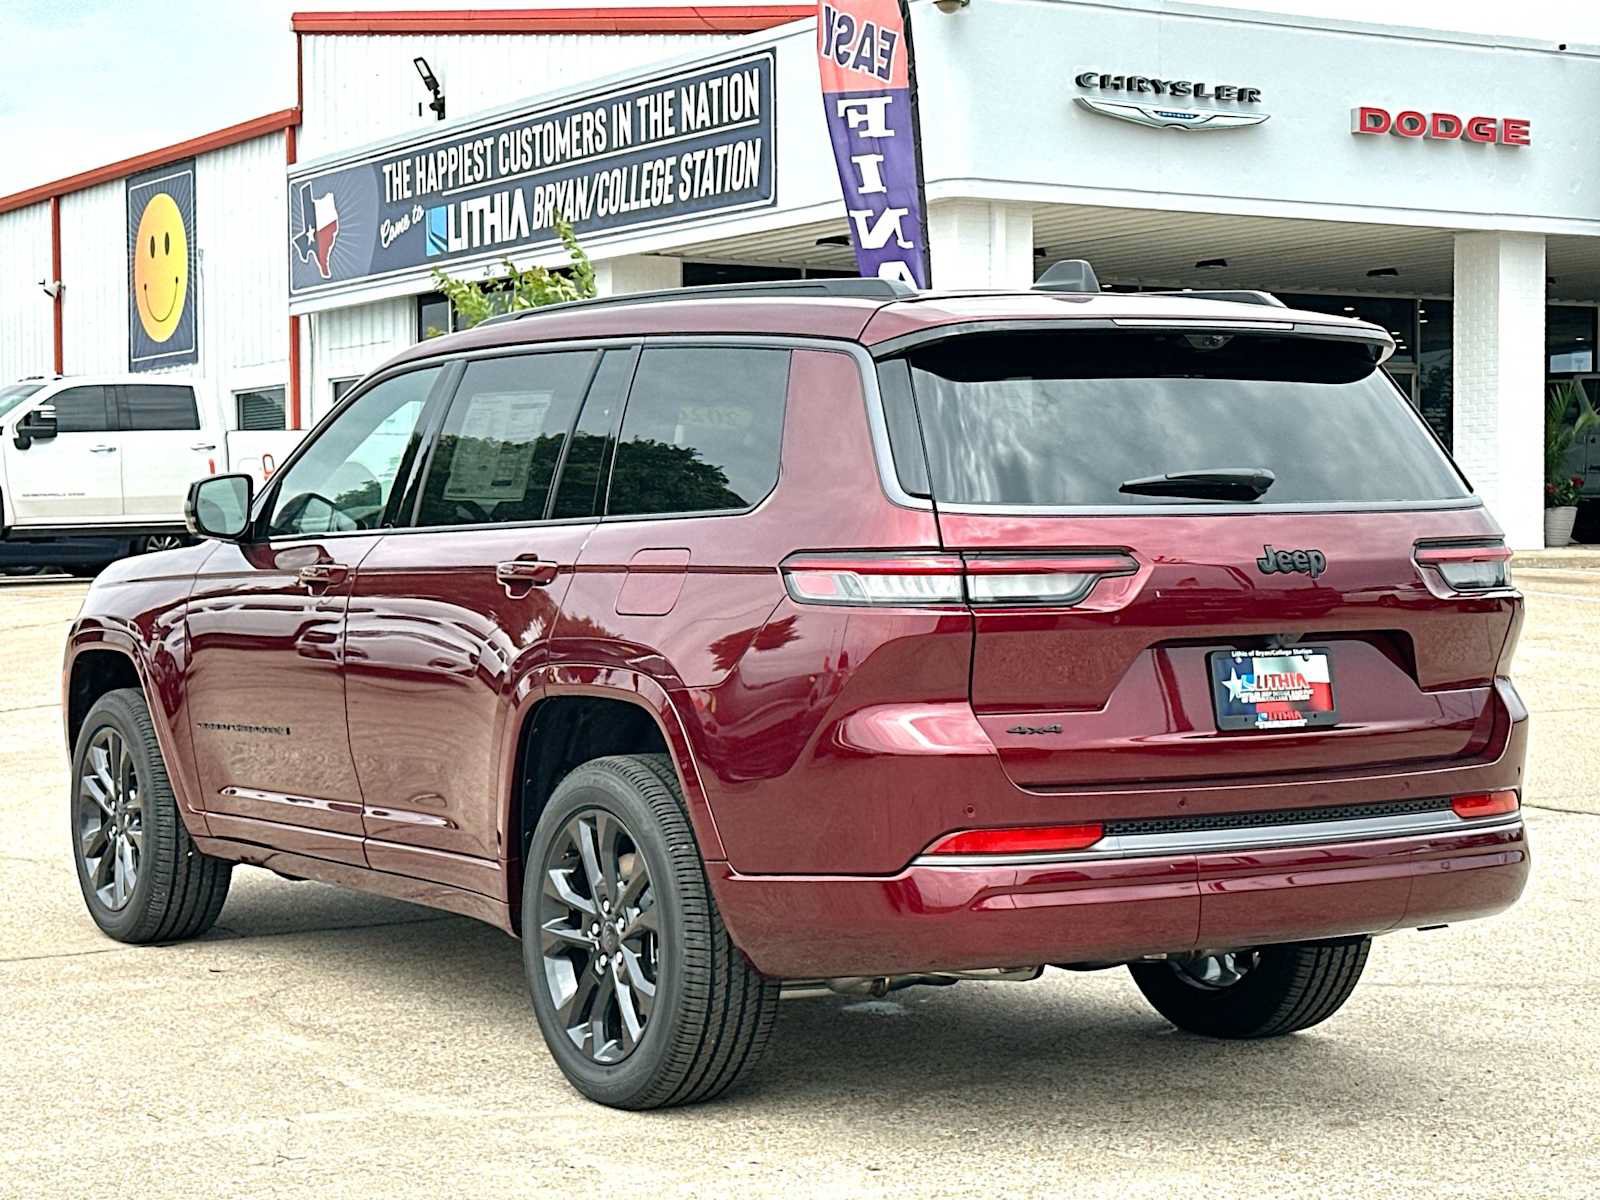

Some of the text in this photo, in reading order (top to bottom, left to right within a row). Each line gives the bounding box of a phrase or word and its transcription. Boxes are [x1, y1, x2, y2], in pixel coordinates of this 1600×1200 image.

[1074, 71, 1262, 103] CHRYSLER
[383, 68, 760, 203] THE HAPPIEST CUSTOMERS IN THE NATION
[1353, 106, 1532, 146] DODGE
[380, 138, 762, 253] Come to LITHIA BRYAN/COLLEGE STATION
[1256, 544, 1327, 578] Jeep
[1256, 672, 1309, 690] LITHIA
